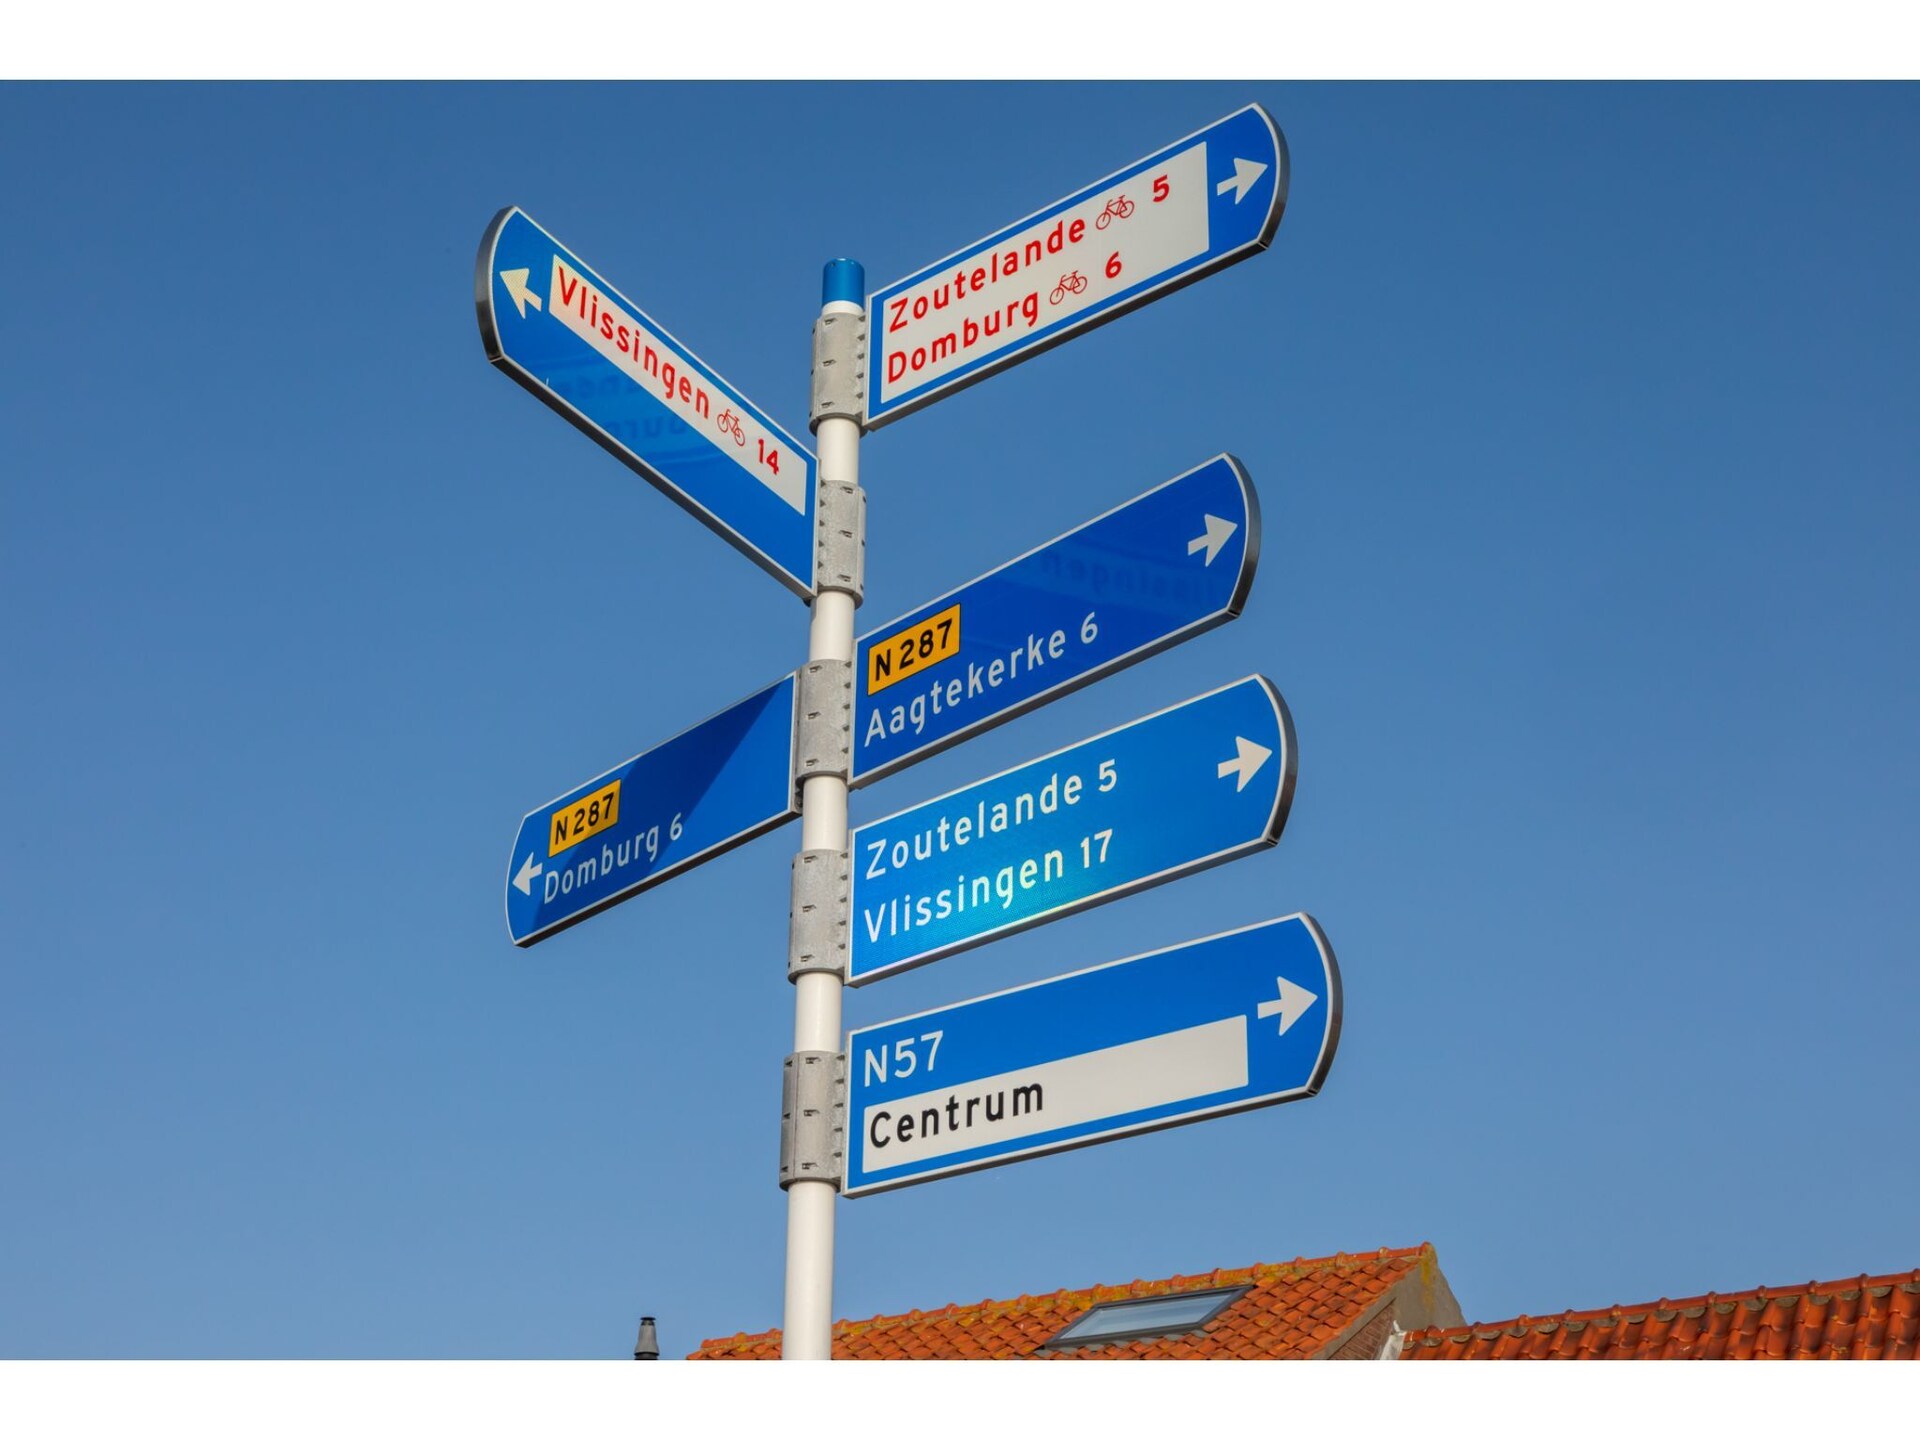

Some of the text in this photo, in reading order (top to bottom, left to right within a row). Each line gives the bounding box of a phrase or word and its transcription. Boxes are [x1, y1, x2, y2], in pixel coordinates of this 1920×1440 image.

[889, 174, 1170, 333] Zoutelande 5
[557, 265, 780, 476] Vlissingen 14
[887, 251, 1123, 384] Domburg 6
[865, 612, 1098, 746] Aagtekerke 6
[544, 813, 683, 904] Domburg 6
[865, 759, 1118, 880] Zoutelande 5
[863, 828, 1114, 943] Vlissingen 17
[863, 1030, 945, 1087] N57
[870, 1082, 1043, 1149] Centrum
